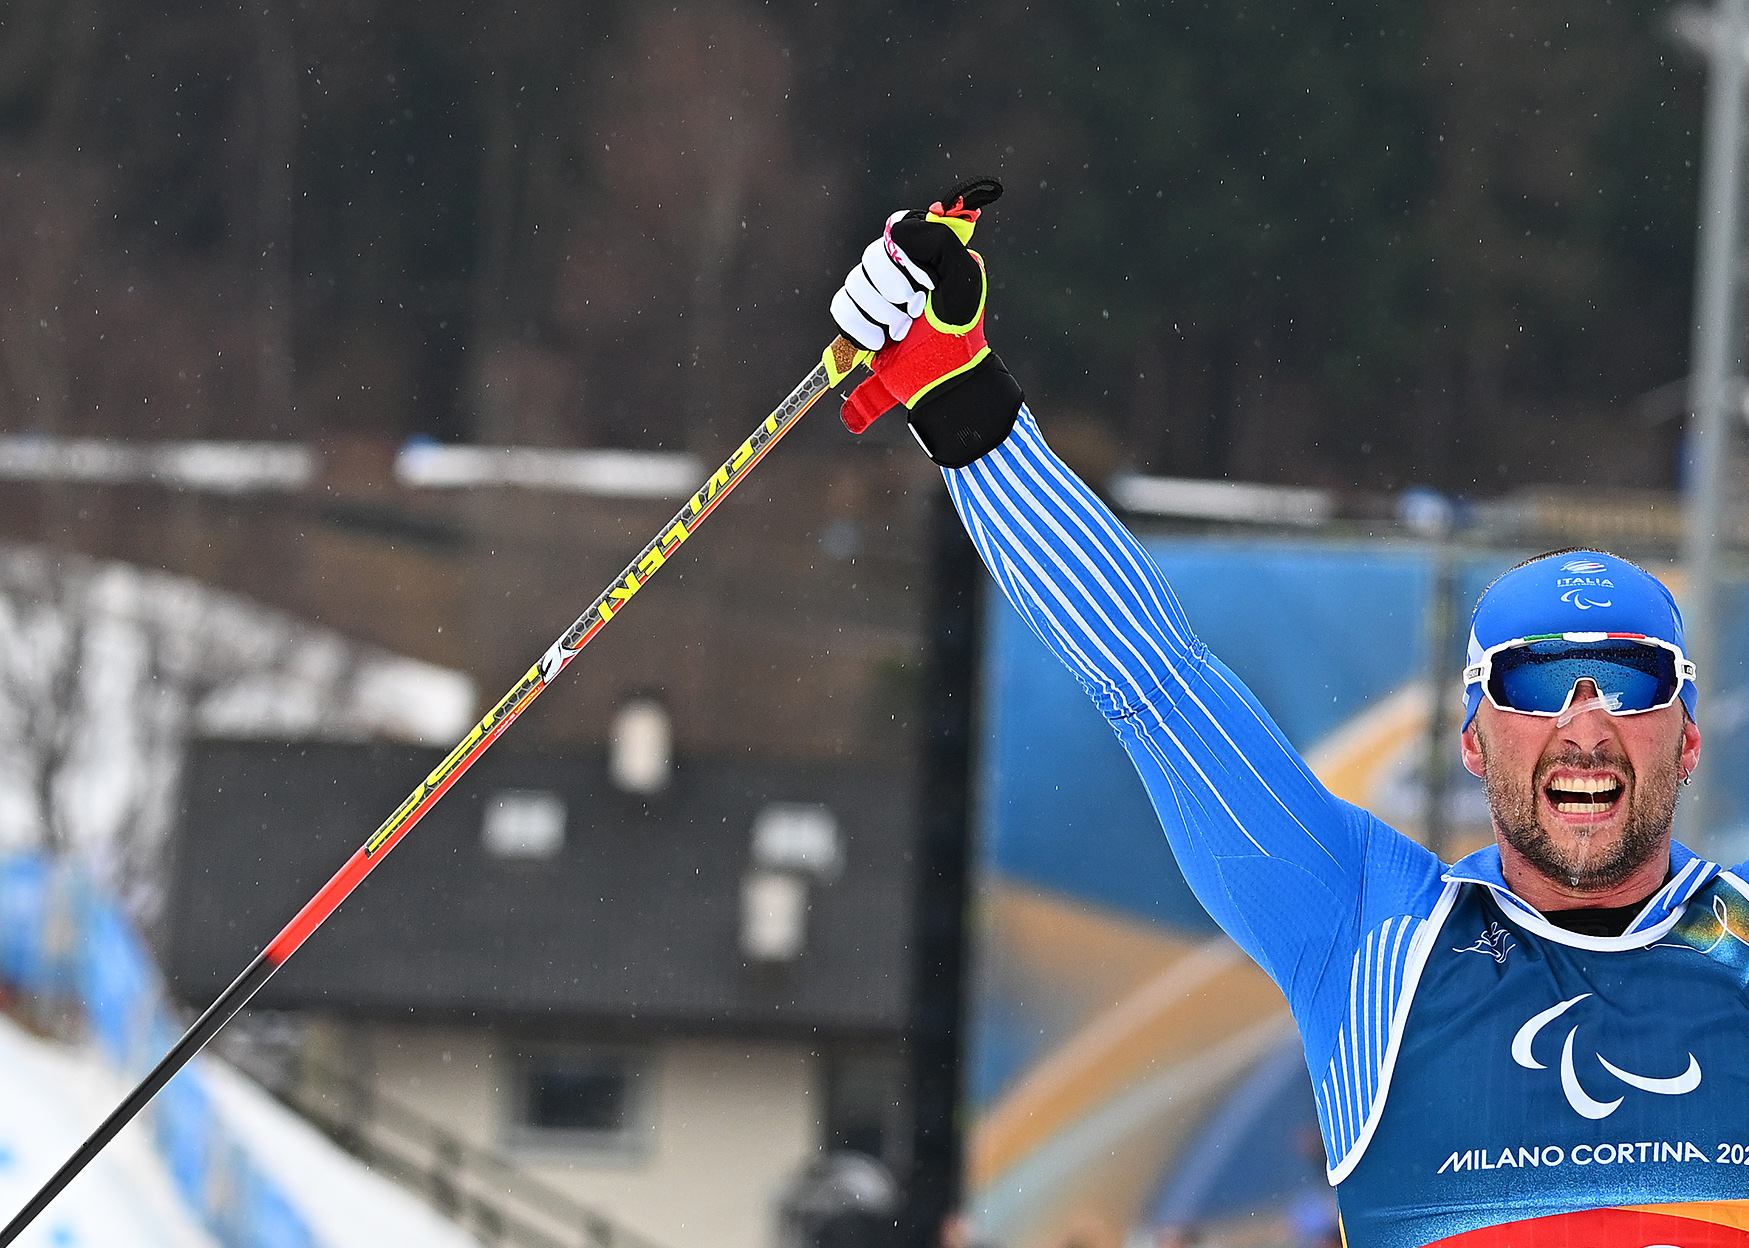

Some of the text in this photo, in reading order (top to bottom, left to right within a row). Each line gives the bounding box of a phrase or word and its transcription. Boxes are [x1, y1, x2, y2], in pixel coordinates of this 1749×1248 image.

[598, 520, 690, 623] LEKI
[1556, 577, 1614, 587] ITALIA
[1436, 1146, 1564, 1174] MILANO
[1571, 1141, 1710, 1165] CORTINA
